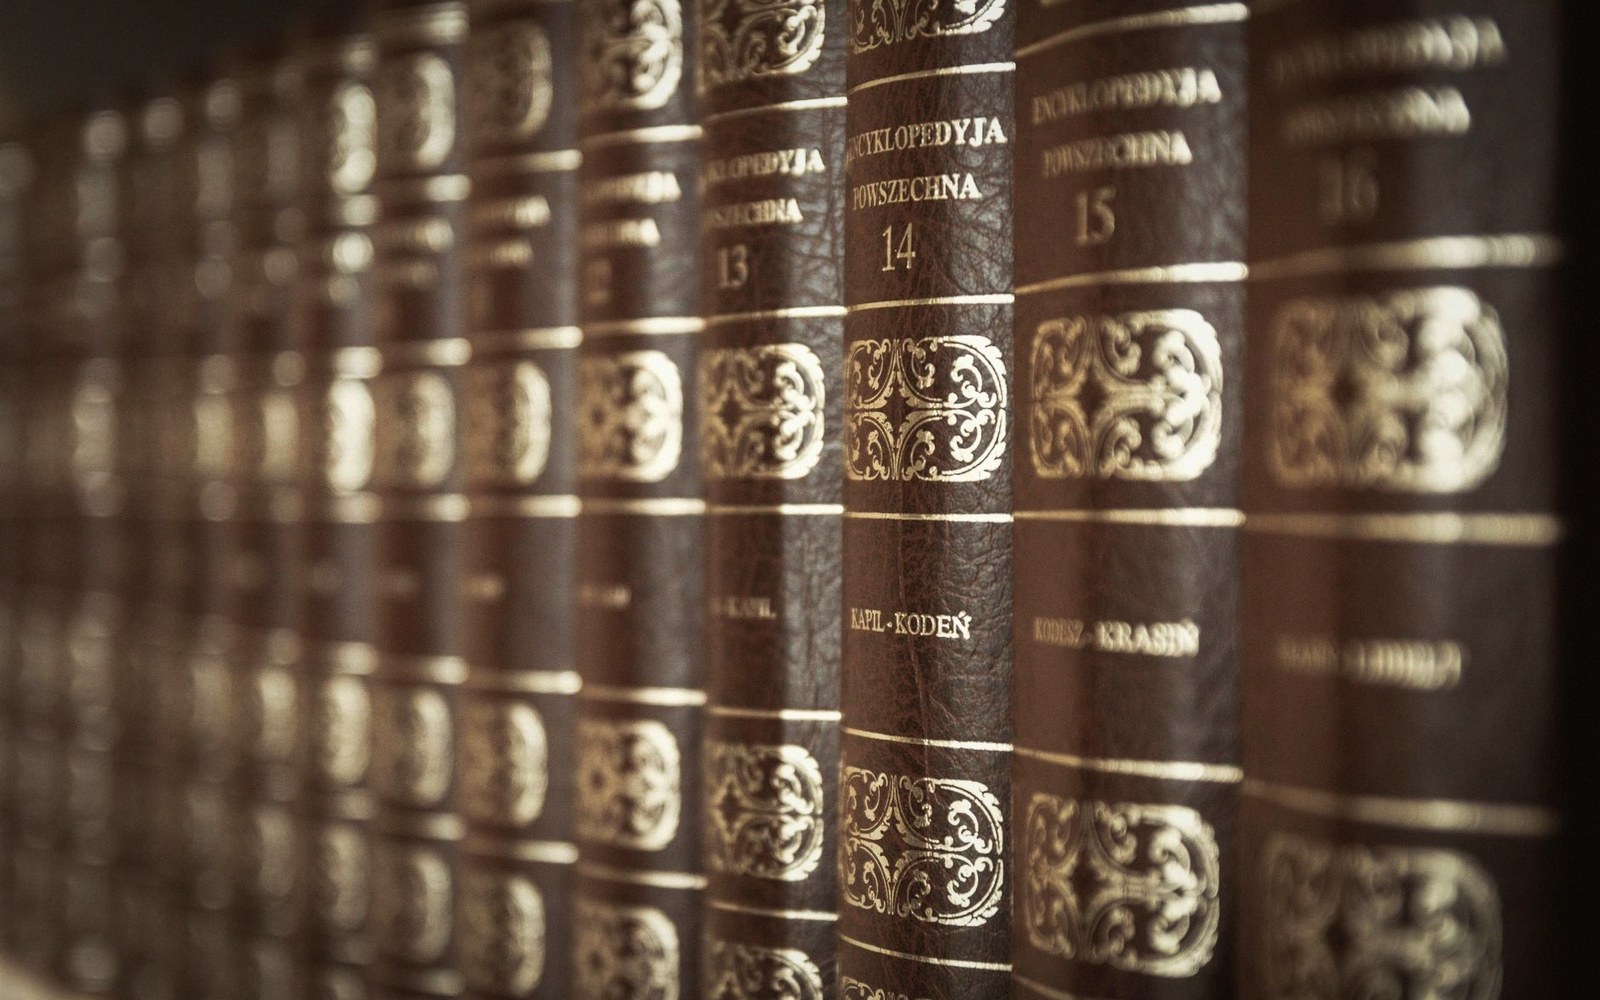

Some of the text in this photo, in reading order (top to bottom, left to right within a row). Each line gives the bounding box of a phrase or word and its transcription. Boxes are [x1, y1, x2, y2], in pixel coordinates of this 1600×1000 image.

[853, 173, 983, 210] POWSZECHNA
[1075, 186, 1116, 245] 15
[718, 244, 749, 289] 13
[881, 221, 916, 272] 14
